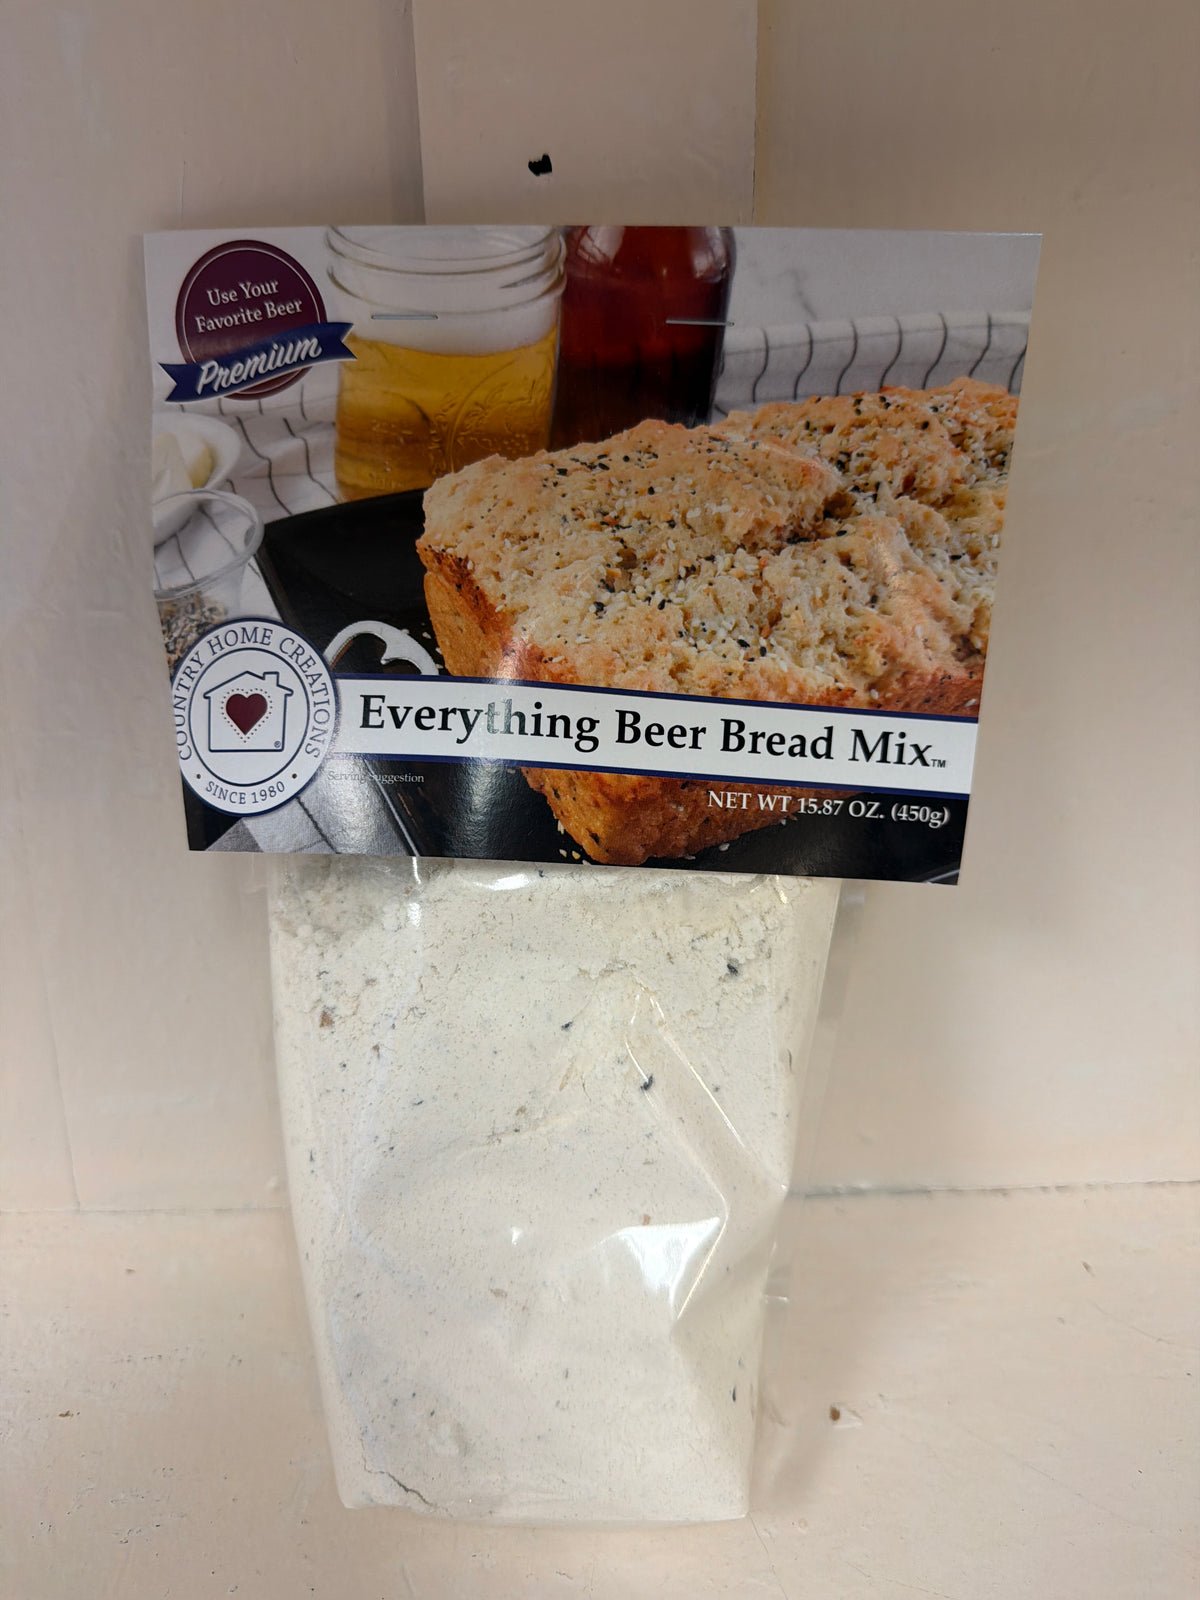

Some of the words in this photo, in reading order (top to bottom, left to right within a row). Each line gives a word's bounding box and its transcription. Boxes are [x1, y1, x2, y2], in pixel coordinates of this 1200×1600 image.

[206, 288, 238, 306] Use
[239, 280, 279, 300] Your
[194, 308, 263, 333] Favorite
[264, 299, 303, 320] Beer
[196, 336, 323, 395] Premium
[173, 651, 205, 761] COUNTRY
[206, 626, 274, 656] HOME
[279, 637, 331, 759] CREATIONS
[359, 694, 600, 752] Everything
[615, 709, 707, 750] Beer
[720, 718, 835, 761] Bread
[205, 781, 247, 805] SINCE
[251, 780, 286, 805] 1980
[707, 790, 752, 810] NET
[757, 794, 792, 813] WT
[797, 797, 844, 816] 15.87
[848, 800, 885, 819] OZ.
[890, 802, 950, 828] (450g)
